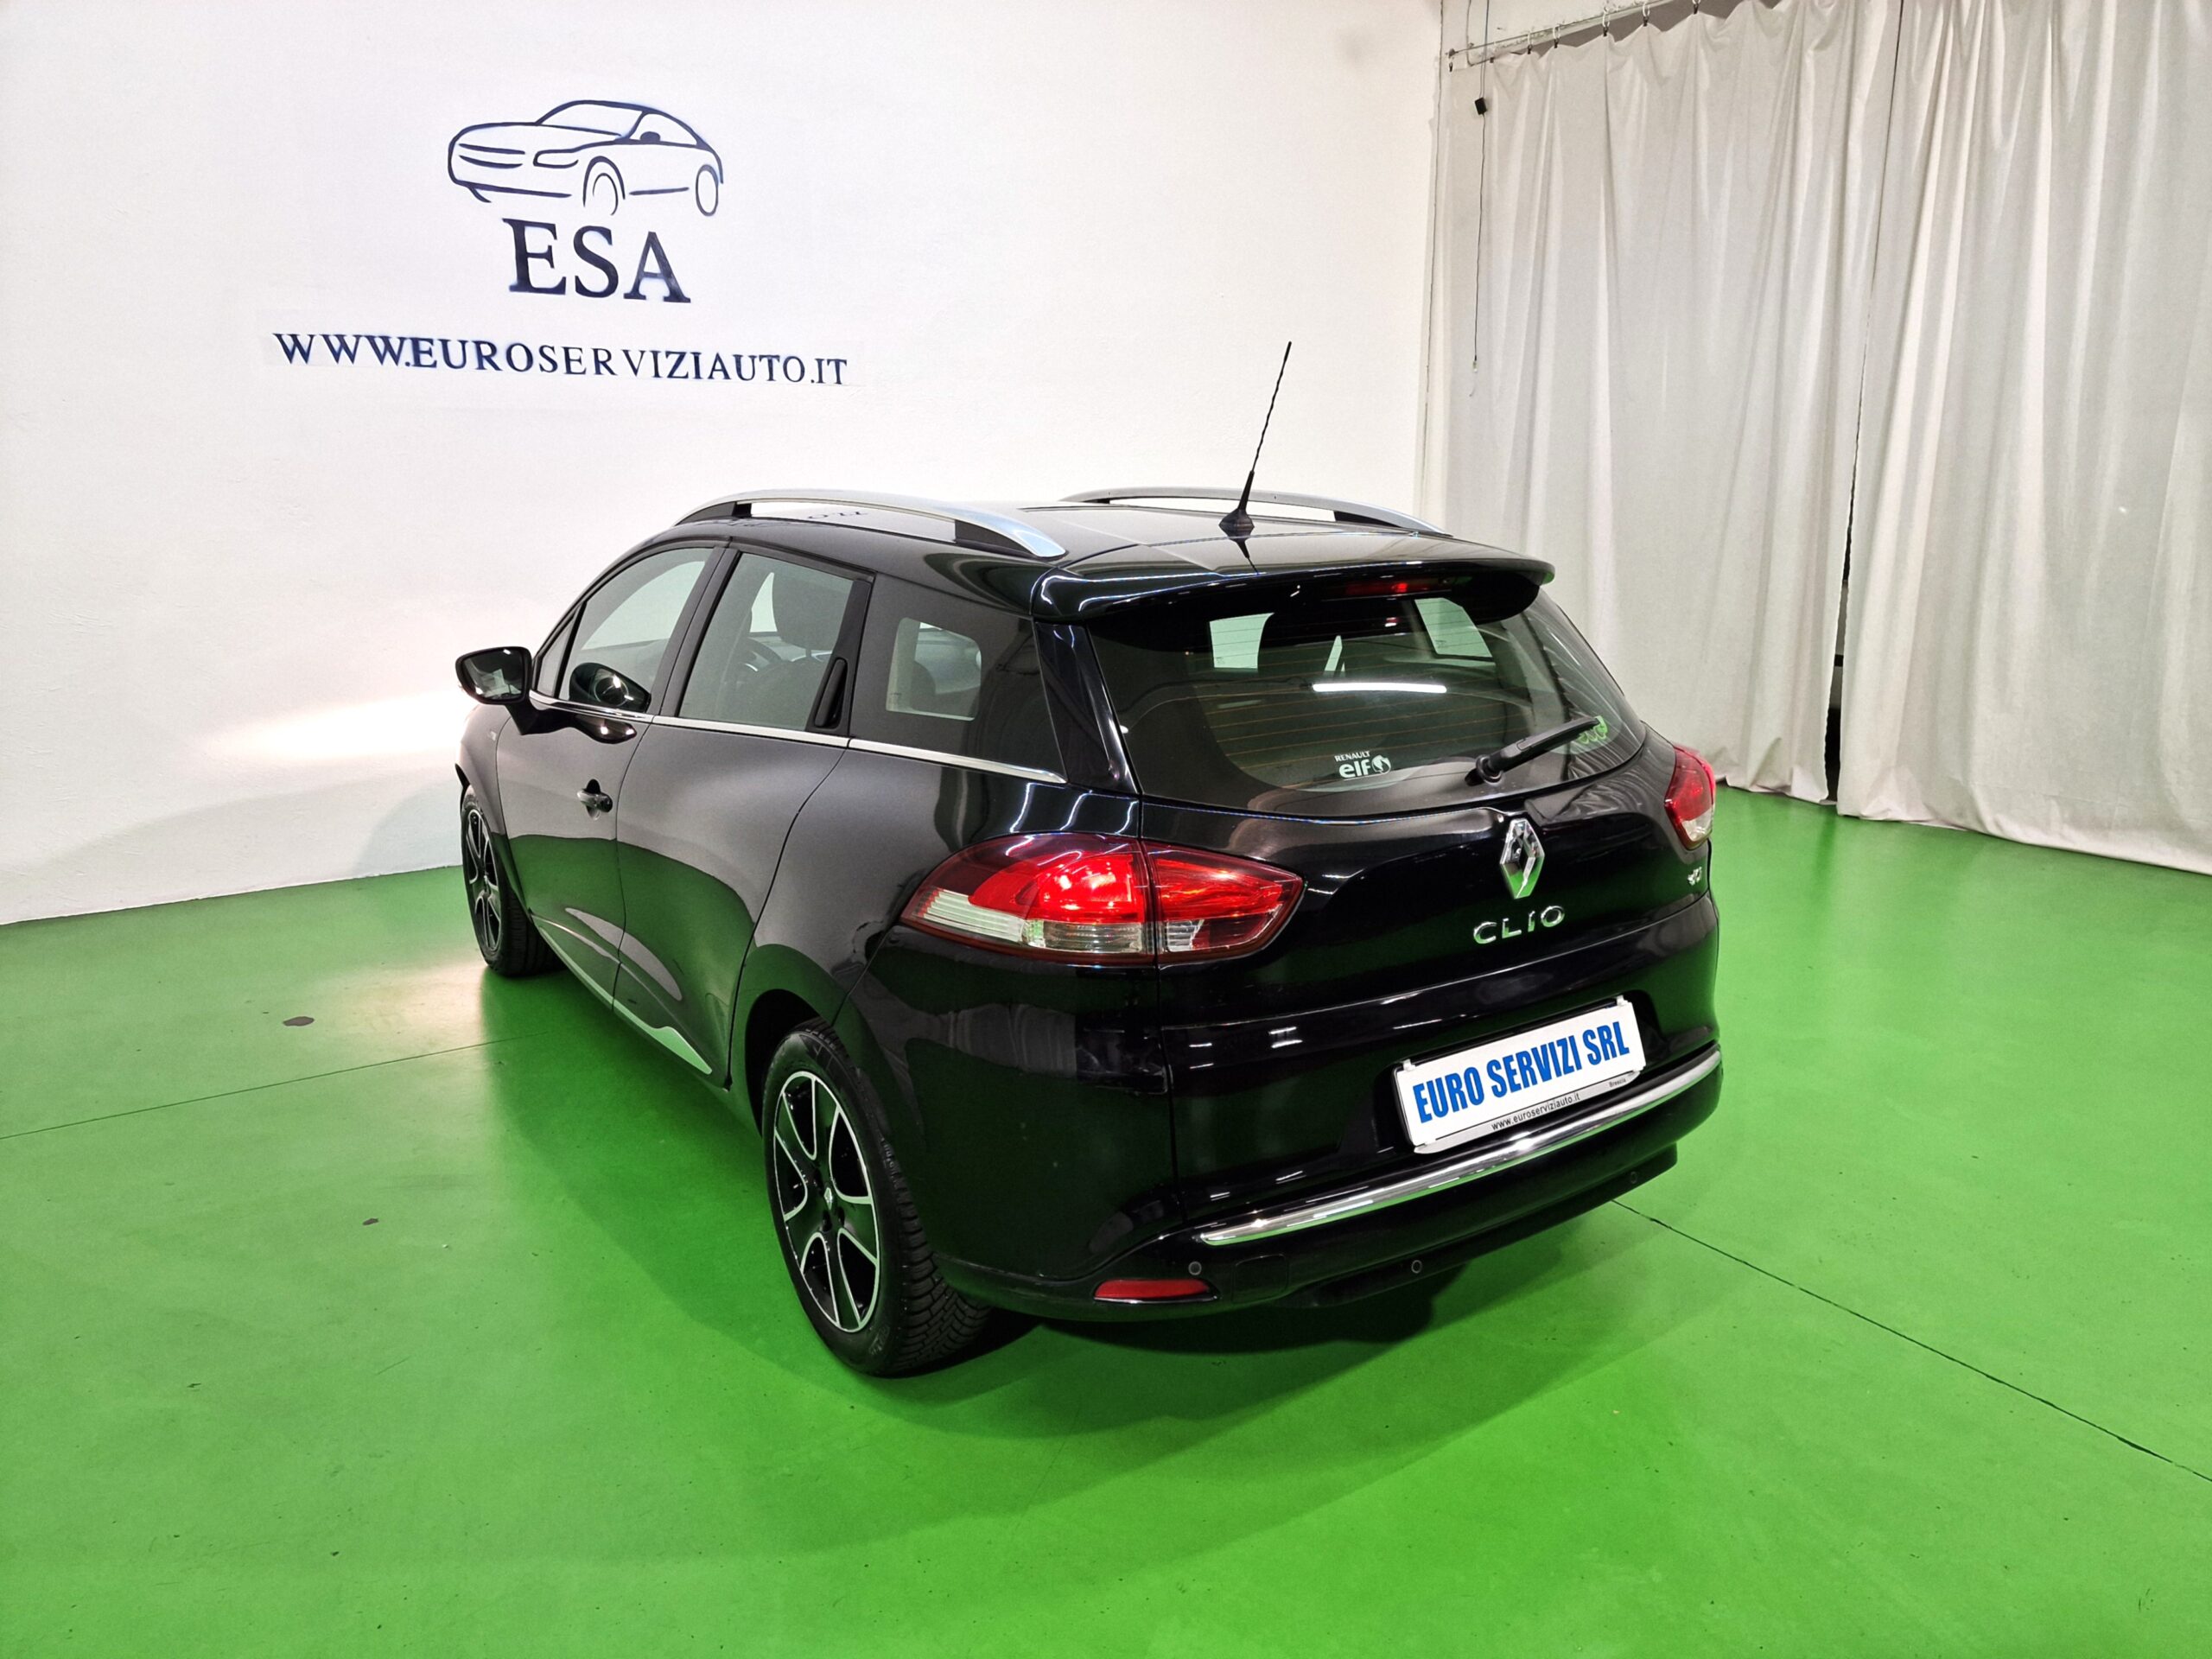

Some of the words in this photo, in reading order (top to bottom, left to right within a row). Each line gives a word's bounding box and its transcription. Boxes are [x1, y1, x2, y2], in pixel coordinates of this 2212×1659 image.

[503, 219, 691, 303] ESA
[273, 334, 848, 385] WWW.EUROSERVIZIAUTO.IT
[1334, 750, 1370, 762] RENAULT
[1339, 759, 1371, 779] elf
[1473, 906, 1565, 944] CLIO
[1413, 1067, 1485, 1124] EURO
[1486, 1035, 1583, 1098] SERVIZI
[1583, 1021, 1630, 1066] SRL
[1491, 1092, 1581, 1131] www.euroserviziauto.it
